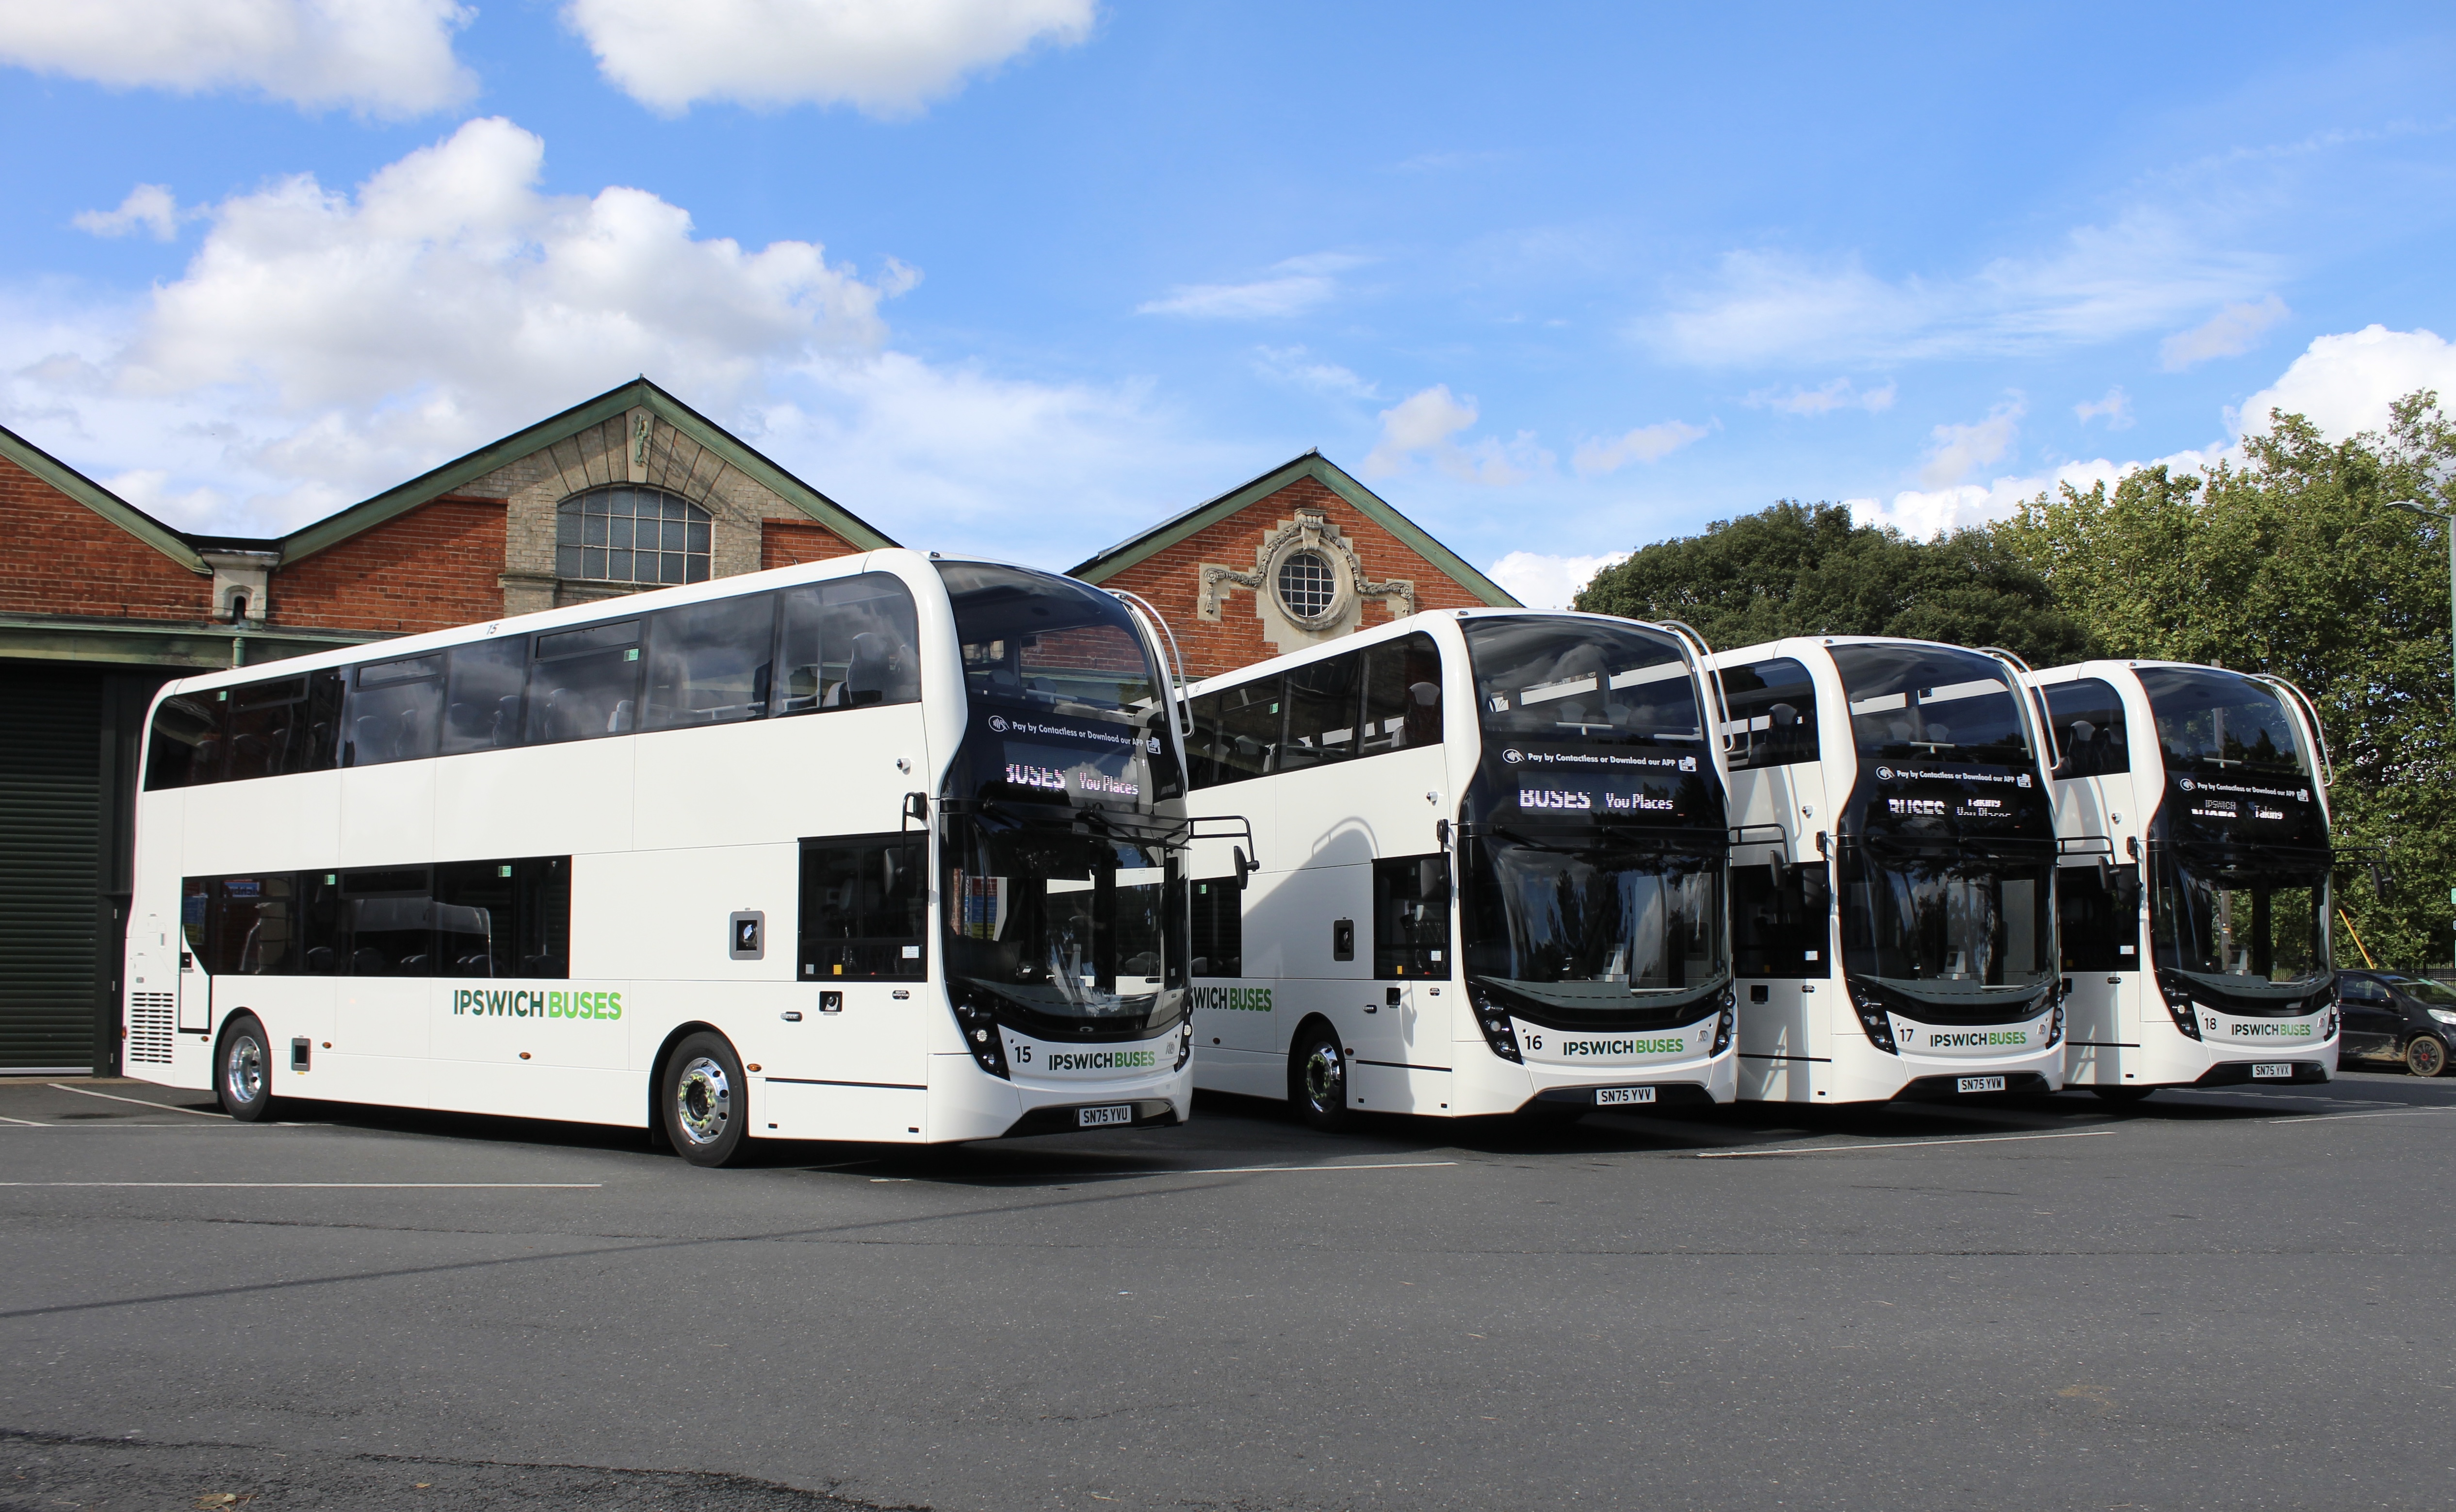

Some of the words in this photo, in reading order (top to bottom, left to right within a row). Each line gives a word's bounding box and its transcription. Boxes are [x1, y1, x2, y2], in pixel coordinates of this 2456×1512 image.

[486, 623, 499, 635] 15
[1193, 683, 1202, 694] 16
[1012, 721, 1026, 732] Pay
[1027, 722, 1037, 733] by
[1039, 725, 1077, 737] Contactless
[1087, 731, 1120, 743] Download
[1132, 738, 1143, 747] APP
[1528, 753, 1543, 763] Pay
[1545, 753, 1554, 763] by
[1555, 753, 1598, 763] Contactless
[1610, 756, 1646, 765] Download
[1661, 758, 1675, 766] APP
[1896, 770, 1909, 779] Pay
[1910, 771, 1918, 779] by
[1919, 771, 1954, 780] Contactless
[1963, 773, 1992, 781] Download
[1079, 771, 1101, 791] You
[1103, 775, 1139, 796] Places
[2216, 783, 2245, 792] Contactless
[2252, 787, 2277, 795] Download
[1519, 789, 1592, 809] BUSES
[1605, 793, 1629, 809] You
[1632, 794, 1674, 810] Places
[454, 990, 544, 1017] IPSWICH
[549, 991, 622, 1020] BUSES
[1191, 987, 1227, 1009] WICH
[1230, 988, 1272, 1012] BUSES
[2204, 1018, 2216, 1030] 18
[2231, 1024, 2278, 1036] IPSWICH
[2280, 1024, 2310, 1036] BUSES
[1525, 1035, 1542, 1050] 16
[1899, 1029, 1914, 1042] 17
[1930, 1033, 1987, 1047] IPSWICH
[1989, 1032, 2026, 1045] BUSES
[1015, 1046, 1031, 1063] 15
[1563, 1040, 1633, 1056] IPSWICH
[1636, 1039, 1684, 1053] BUSES
[1049, 1053, 1113, 1071] IPSWICH
[1115, 1051, 1155, 1068] BUSES
[2256, 1066, 2274, 1075] SN75
[2276, 1065, 2289, 1075] YVX
[1962, 1079, 1984, 1090] SN75
[1986, 1078, 2001, 1089] YVW
[1601, 1090, 1628, 1102] SN75
[1631, 1089, 1651, 1101] YVV
[1084, 1109, 1108, 1123] SN75
[1110, 1107, 1128, 1122] YVU
